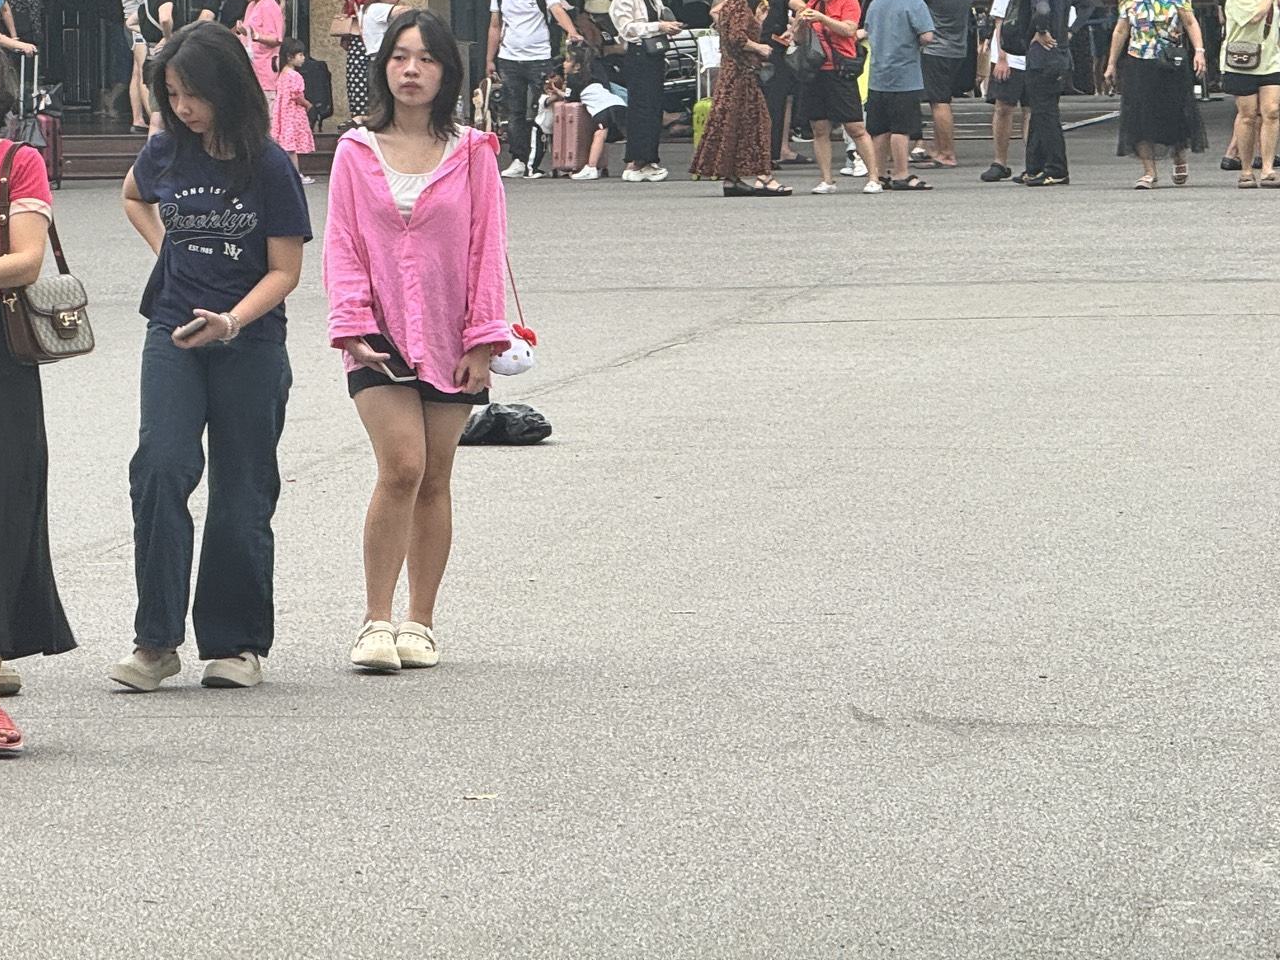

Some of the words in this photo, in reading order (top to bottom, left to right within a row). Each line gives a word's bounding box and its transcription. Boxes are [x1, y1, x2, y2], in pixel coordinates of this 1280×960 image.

[174, 187, 205, 199] LONG
[210, 186, 244, 210] ISND
[159, 202, 259, 236] Brooklyn
[223, 242, 243, 260] NY
